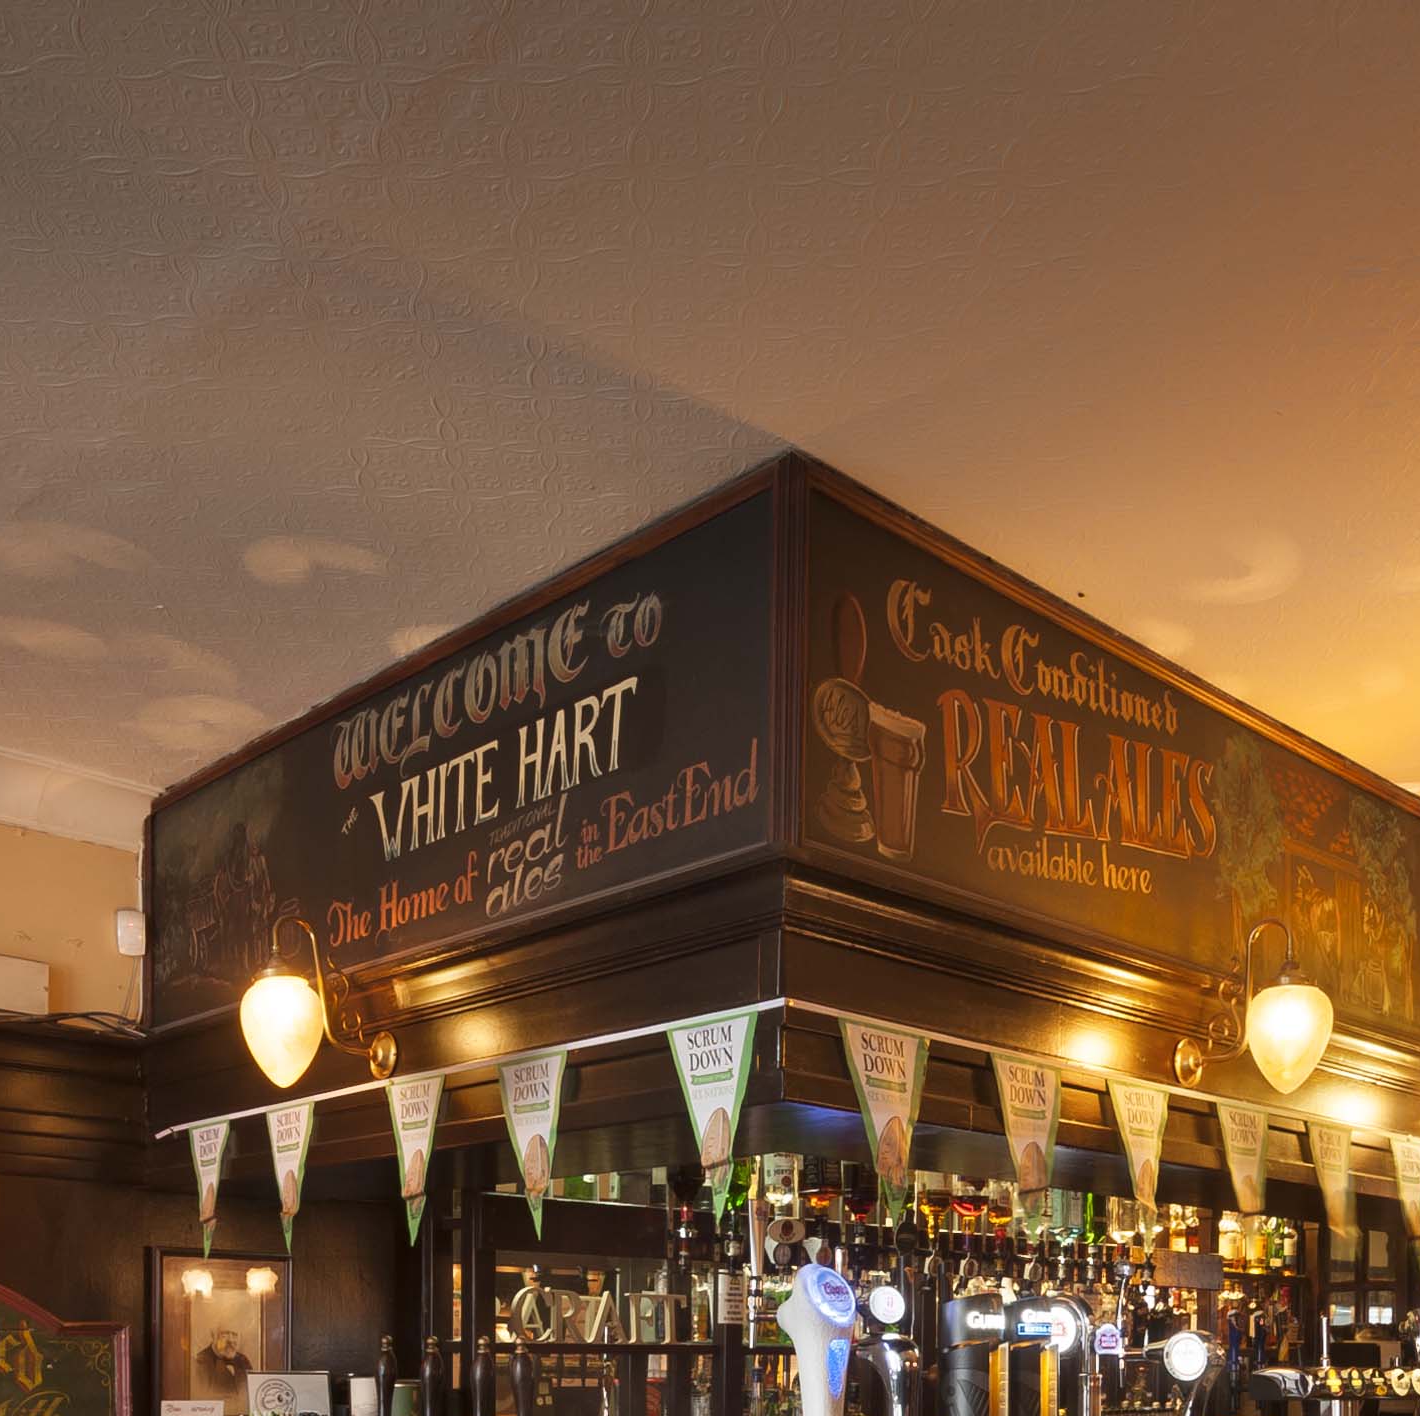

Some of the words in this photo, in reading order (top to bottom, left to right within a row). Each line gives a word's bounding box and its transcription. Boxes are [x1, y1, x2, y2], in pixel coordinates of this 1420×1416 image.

[887, 579, 1001, 680] Cask
[1001, 624, 1178, 735] Conditioned
[333, 600, 590, 790] WELCOME
[600, 590, 662, 658] TO
[369, 739, 500, 862] WHITE
[515, 676, 638, 808] HART
[937, 689, 1111, 855] REAL
[1094, 733, 1218, 861] ALES
[600, 789, 681, 856] East
[677, 736, 761, 828] End
[341, 806, 359, 836] THE
[488, 803, 557, 850] TRADITIONAL
[581, 817, 600, 845] in
[487, 792, 569, 884] real
[576, 843, 604, 870] the
[986, 838, 1095, 888] available
[1103, 842, 1152, 895] here
[485, 852, 565, 919] ales
[327, 899, 372, 948] The
[379, 879, 450, 931] Home
[454, 850, 480, 905] of
[686, 1025, 734, 1049] SCRUM
[860, 1032, 905, 1058] SCRUM
[689, 1047, 734, 1072] DOWN
[863, 1053, 907, 1079] DOWN
[514, 1062, 549, 1085] SCRUM
[1008, 1065, 1045, 1088] SCRUM
[400, 1083, 430, 1101] SCRUM
[514, 1081, 550, 1102] DOWN
[1009, 1085, 1046, 1107] DOWN
[1124, 1090, 1155, 1109] SCRUM
[276, 1111, 301, 1128] SCRUM
[401, 1100, 430, 1119] DOWN
[1126, 1108, 1155, 1125] DOWN
[1228, 1110, 1258, 1129] SCRUM
[277, 1127, 301, 1144] DOWN
[1230, 1128, 1258, 1145] DOWN
[509, 1286, 687, 1344] CRAFT
